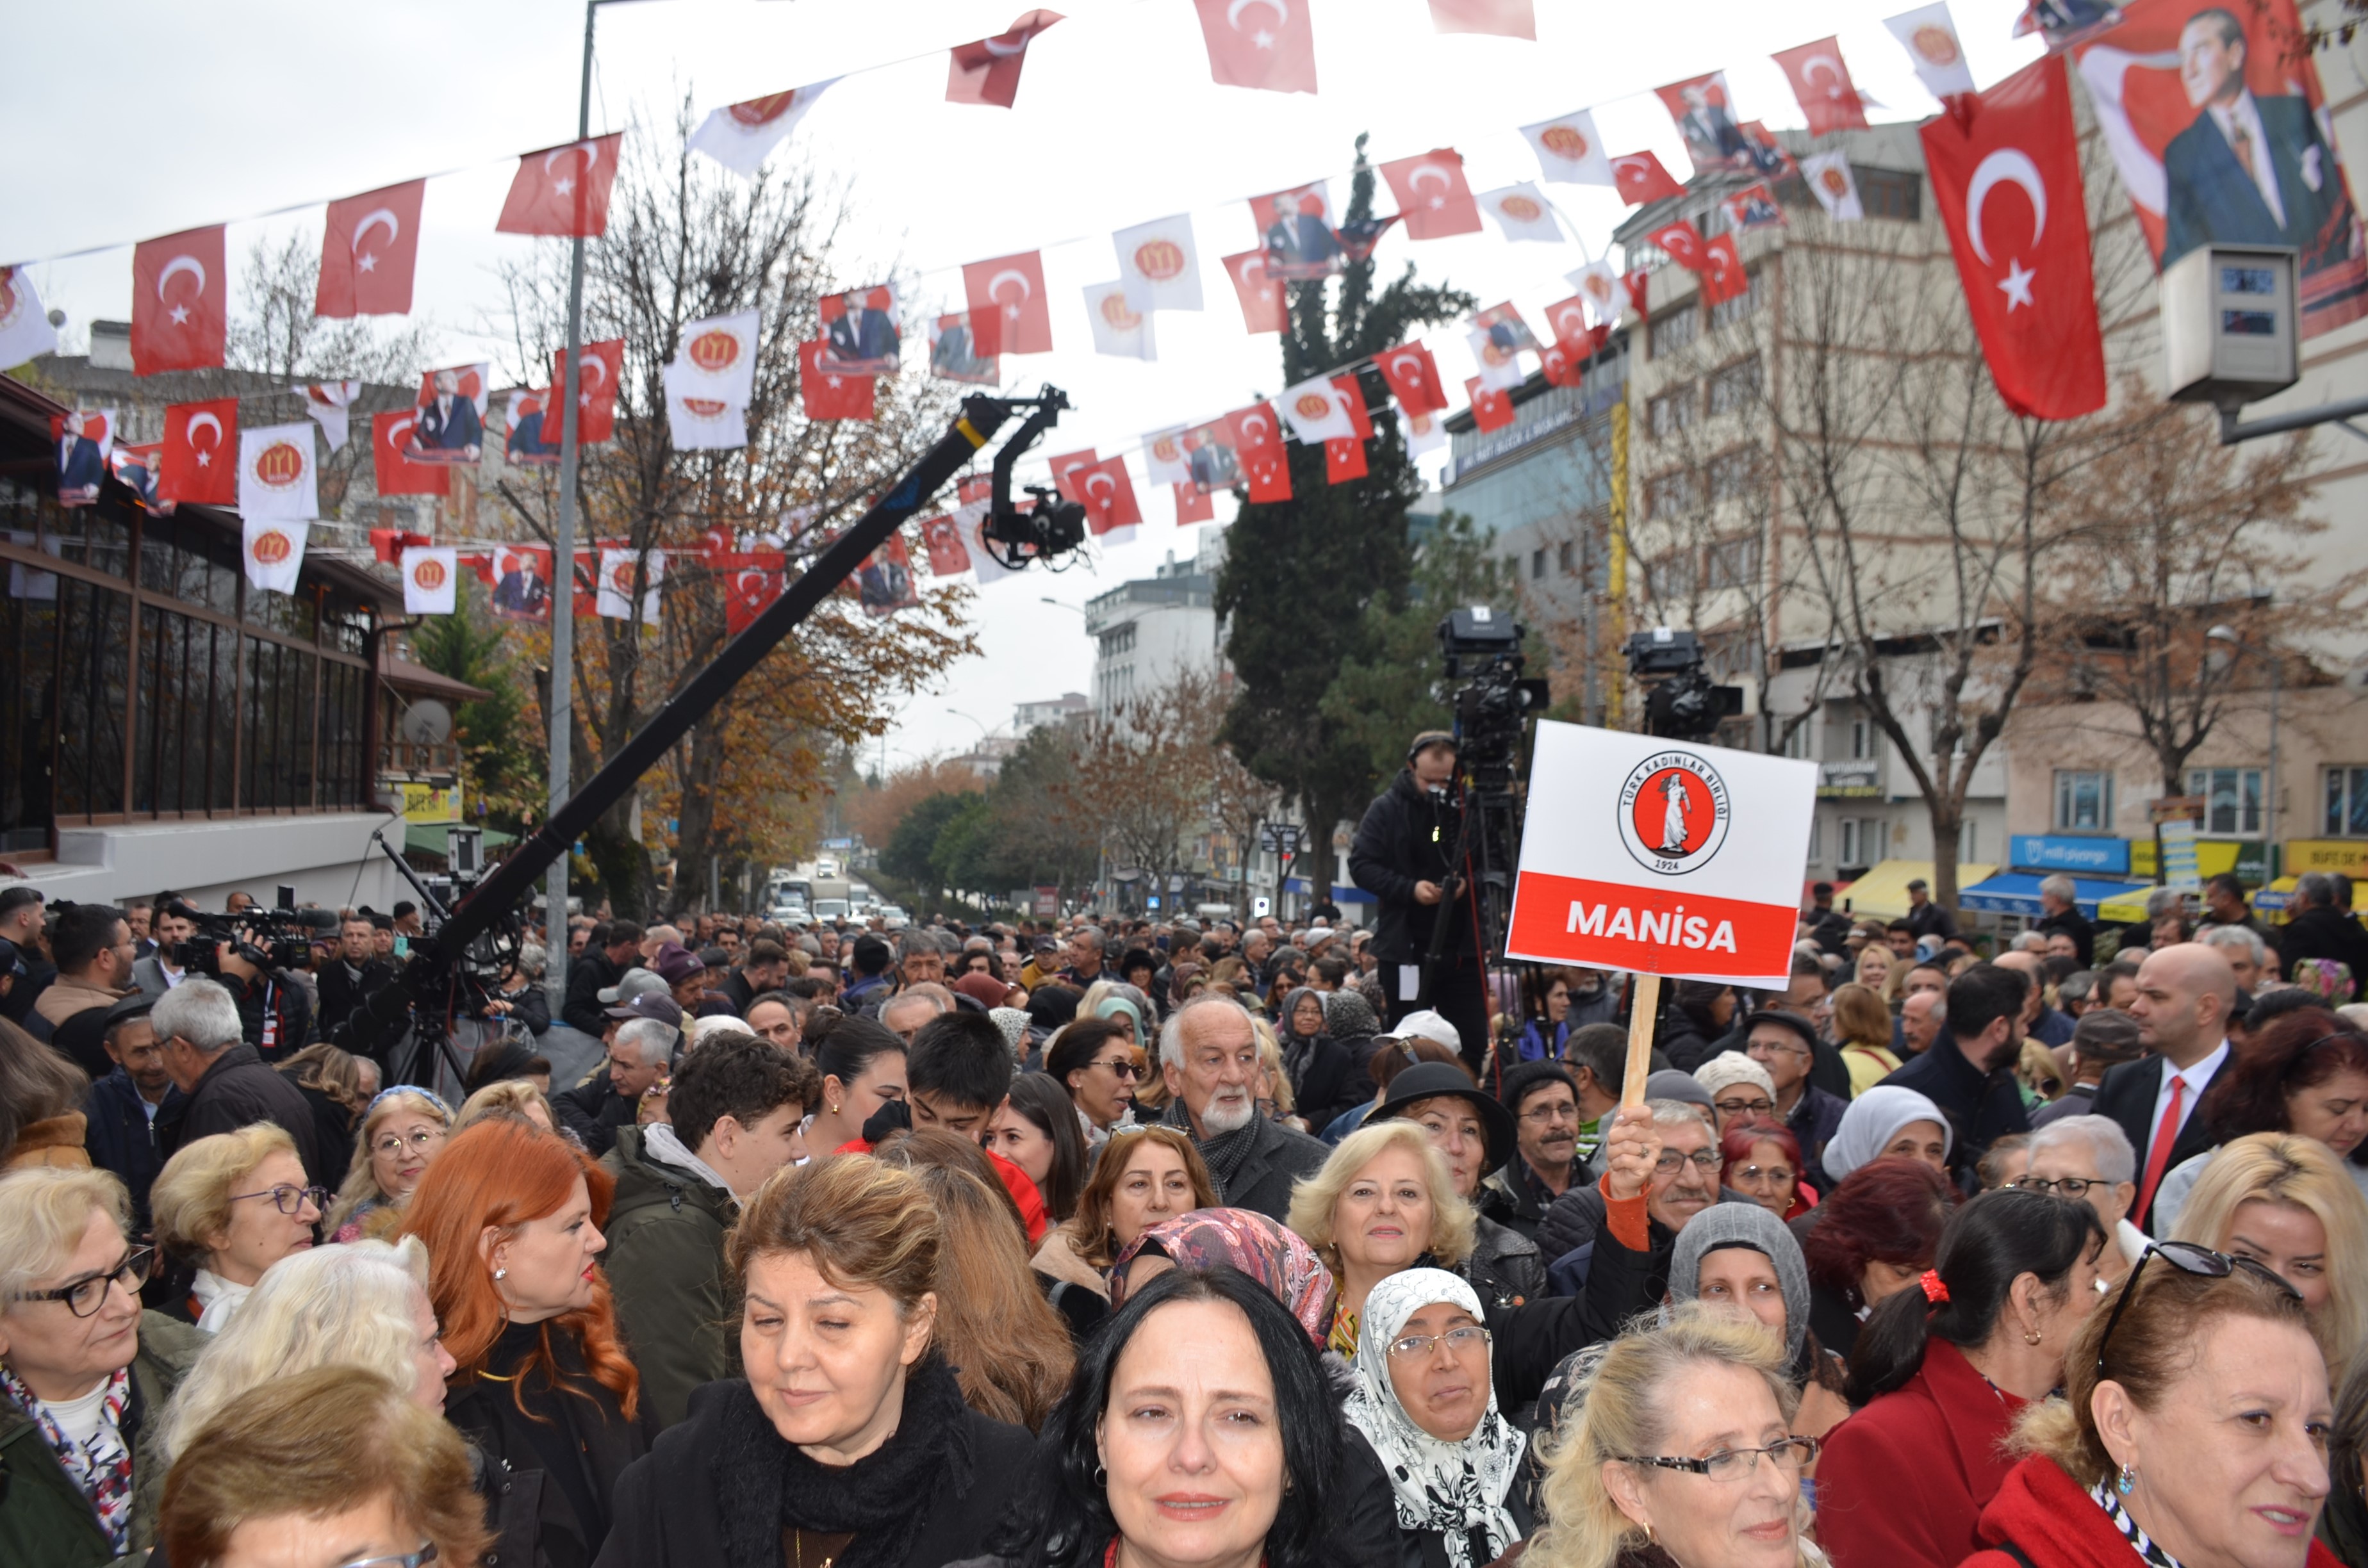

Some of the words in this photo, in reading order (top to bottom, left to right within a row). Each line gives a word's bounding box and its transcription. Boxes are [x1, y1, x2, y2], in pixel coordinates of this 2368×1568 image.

[1623, 773, 1644, 806] TÜRK
[1644, 755, 1706, 776] KADINLAR
[1706, 774, 1728, 821] BİRLİĞİ
[1655, 859, 1679, 870] 1924
[1566, 900, 1737, 953] MANİSA
